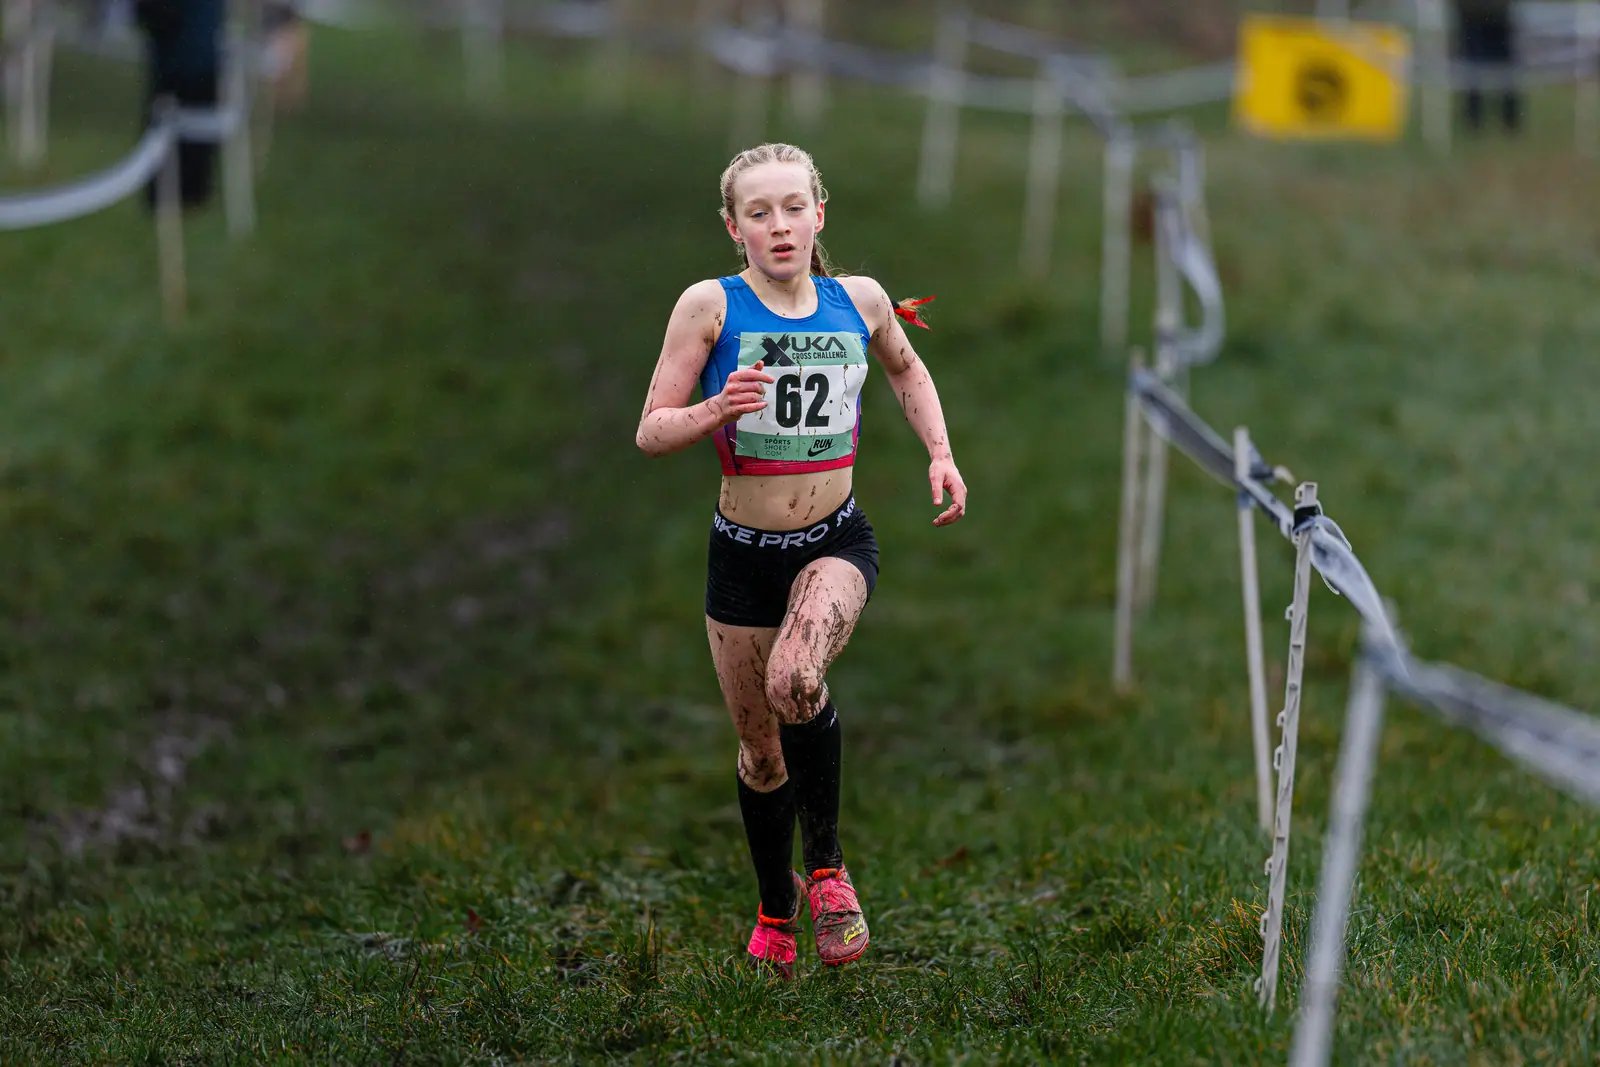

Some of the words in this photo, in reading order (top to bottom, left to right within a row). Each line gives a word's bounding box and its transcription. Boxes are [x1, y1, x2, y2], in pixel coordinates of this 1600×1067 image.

[813, 351, 848, 359] CHALLENGE
[775, 373, 830, 428] 62
[813, 438, 834, 449] RUN
[758, 523, 829, 549] PRO
